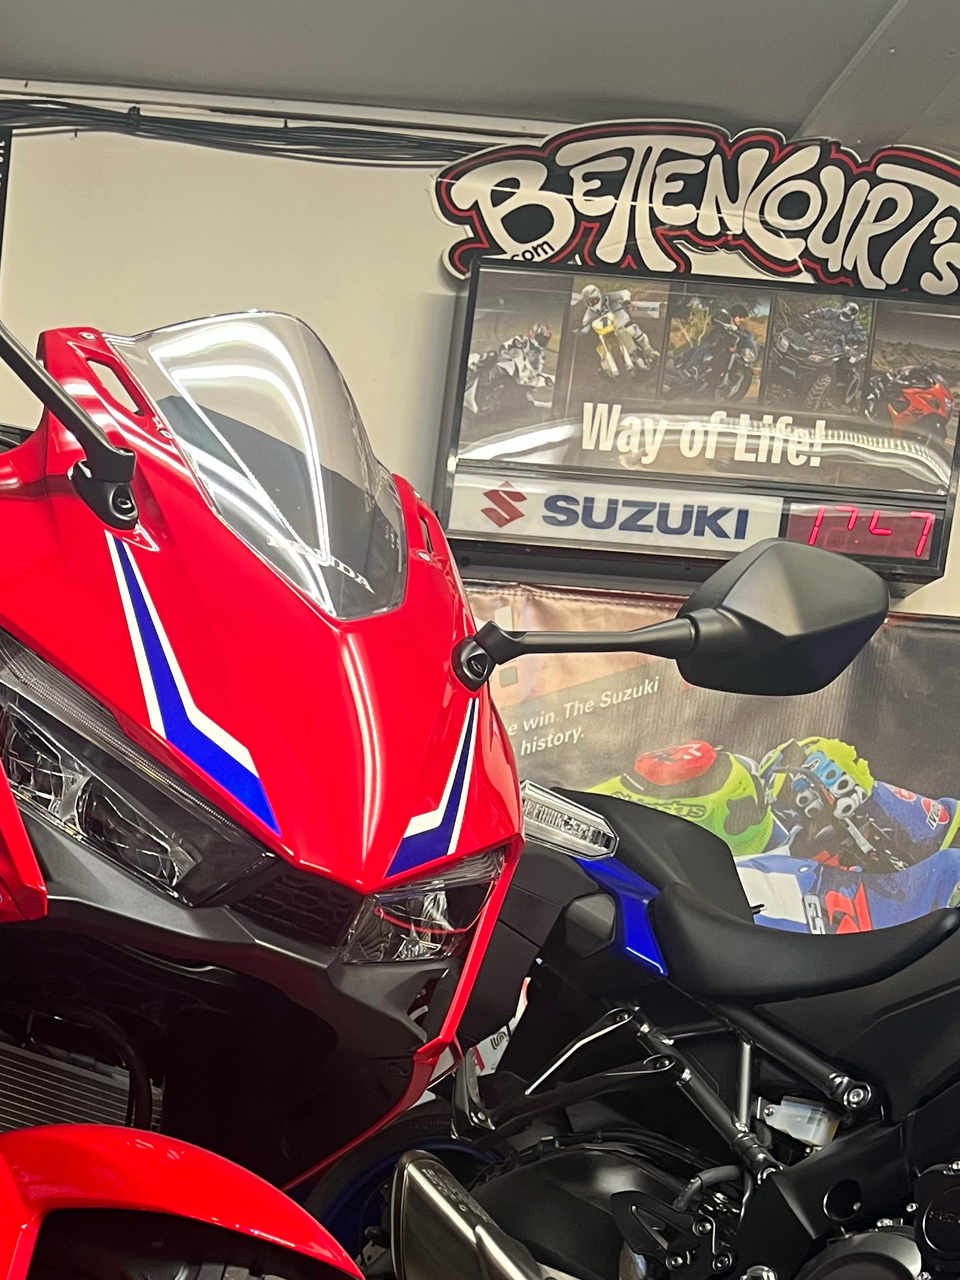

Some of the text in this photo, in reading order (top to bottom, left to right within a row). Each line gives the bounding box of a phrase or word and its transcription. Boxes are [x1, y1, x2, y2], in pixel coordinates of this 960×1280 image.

[581, 401, 828, 468] Way of Life!
[542, 493, 750, 542] SUZUKI
[523, 711, 559, 732] win.
[563, 700, 595, 719] The
[599, 675, 660, 709] Suzuki
[520, 726, 585, 757] history.
